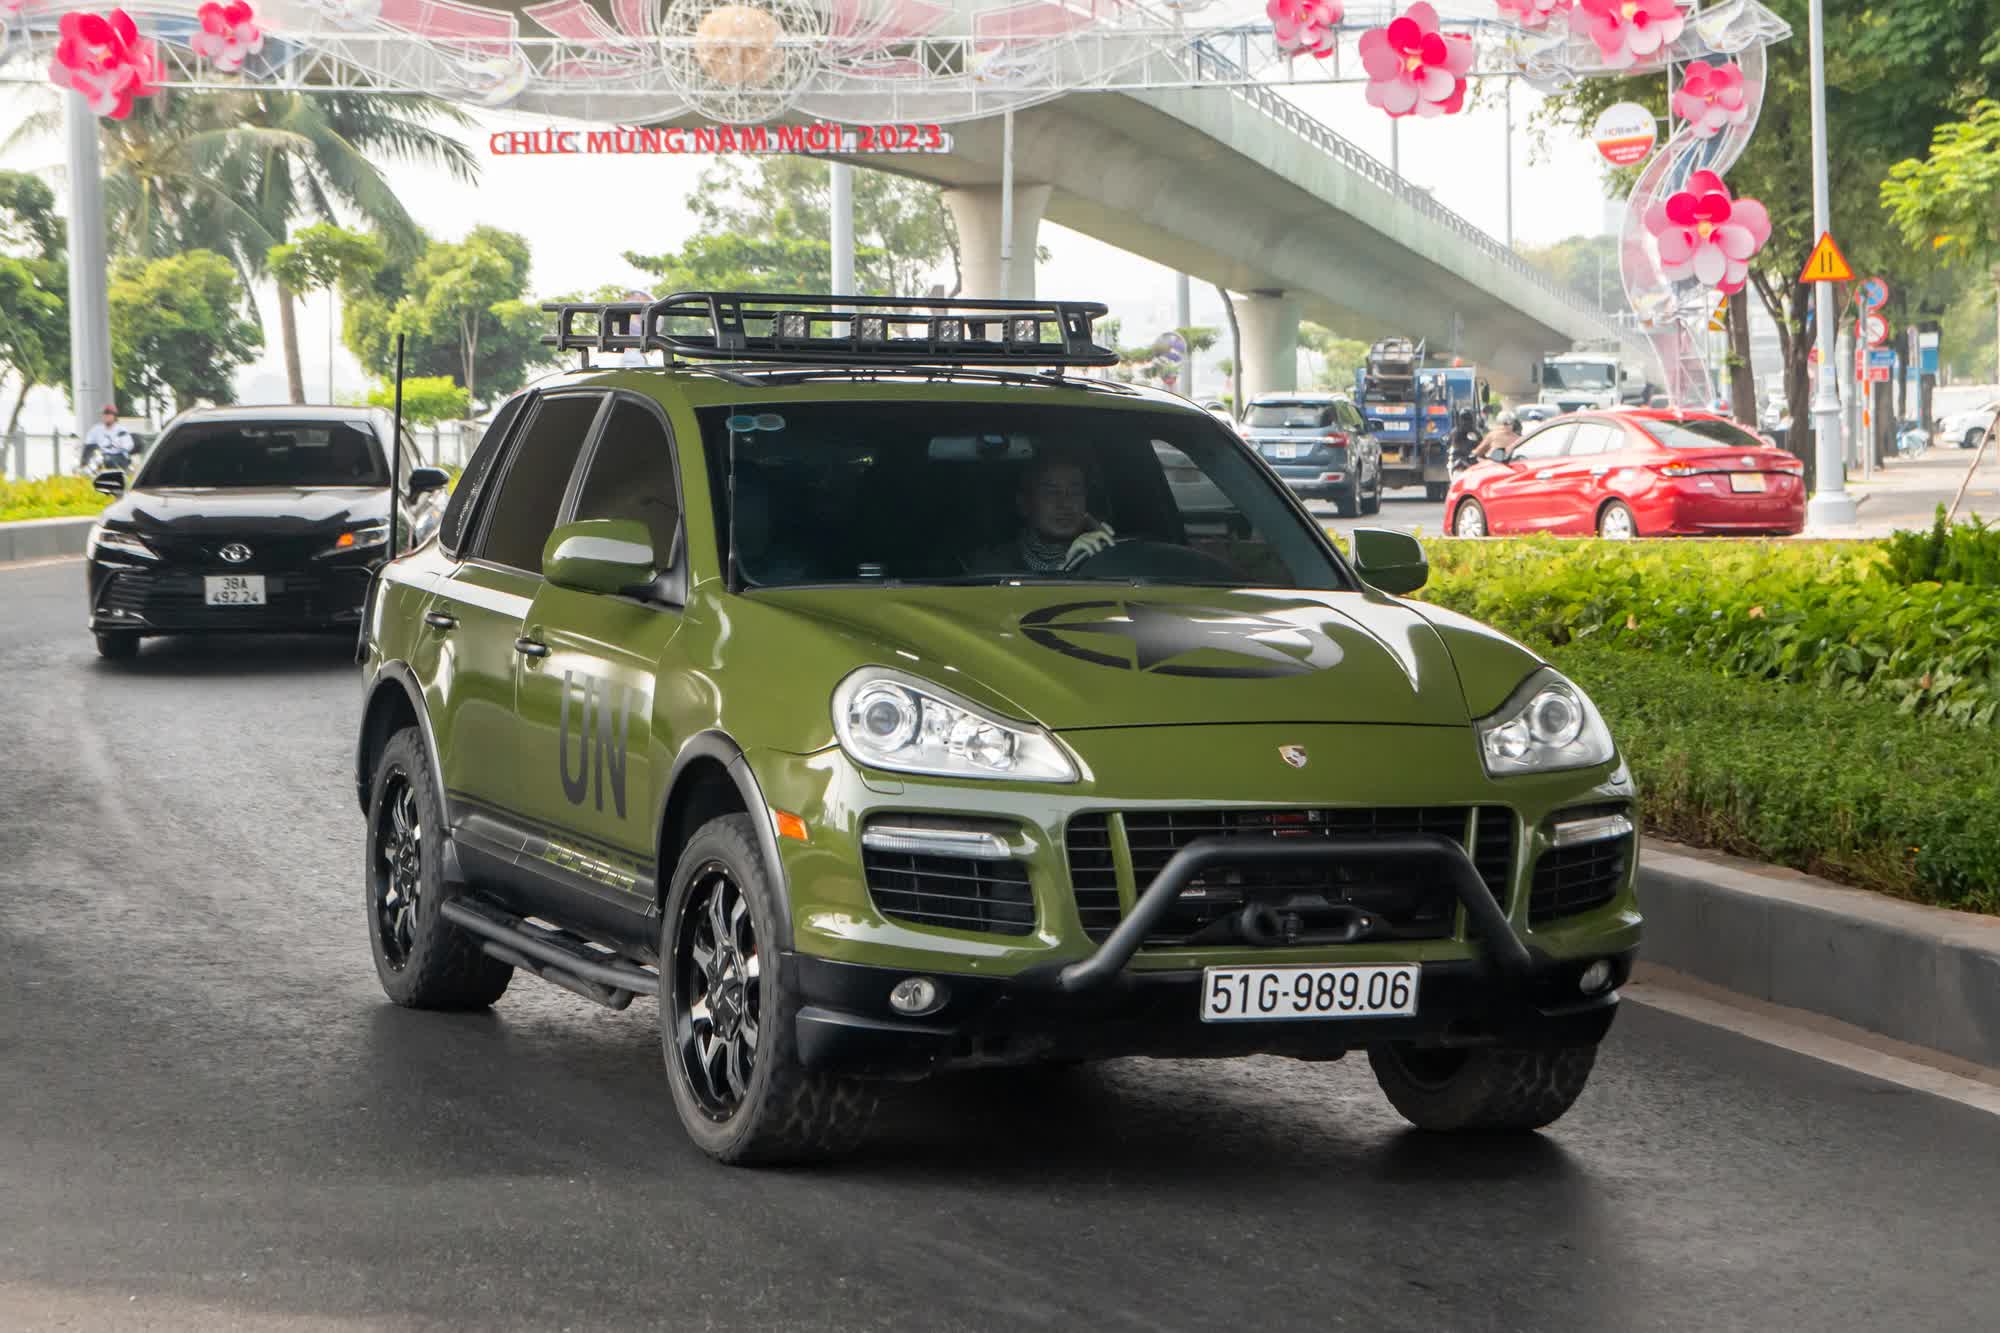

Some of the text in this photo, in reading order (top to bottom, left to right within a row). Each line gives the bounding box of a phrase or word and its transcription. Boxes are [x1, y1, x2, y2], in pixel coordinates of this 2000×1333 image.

[857, 124, 942, 150] 2023
[559, 669, 634, 821] UN
[1211, 970, 1411, 1014] 51G-989.06
